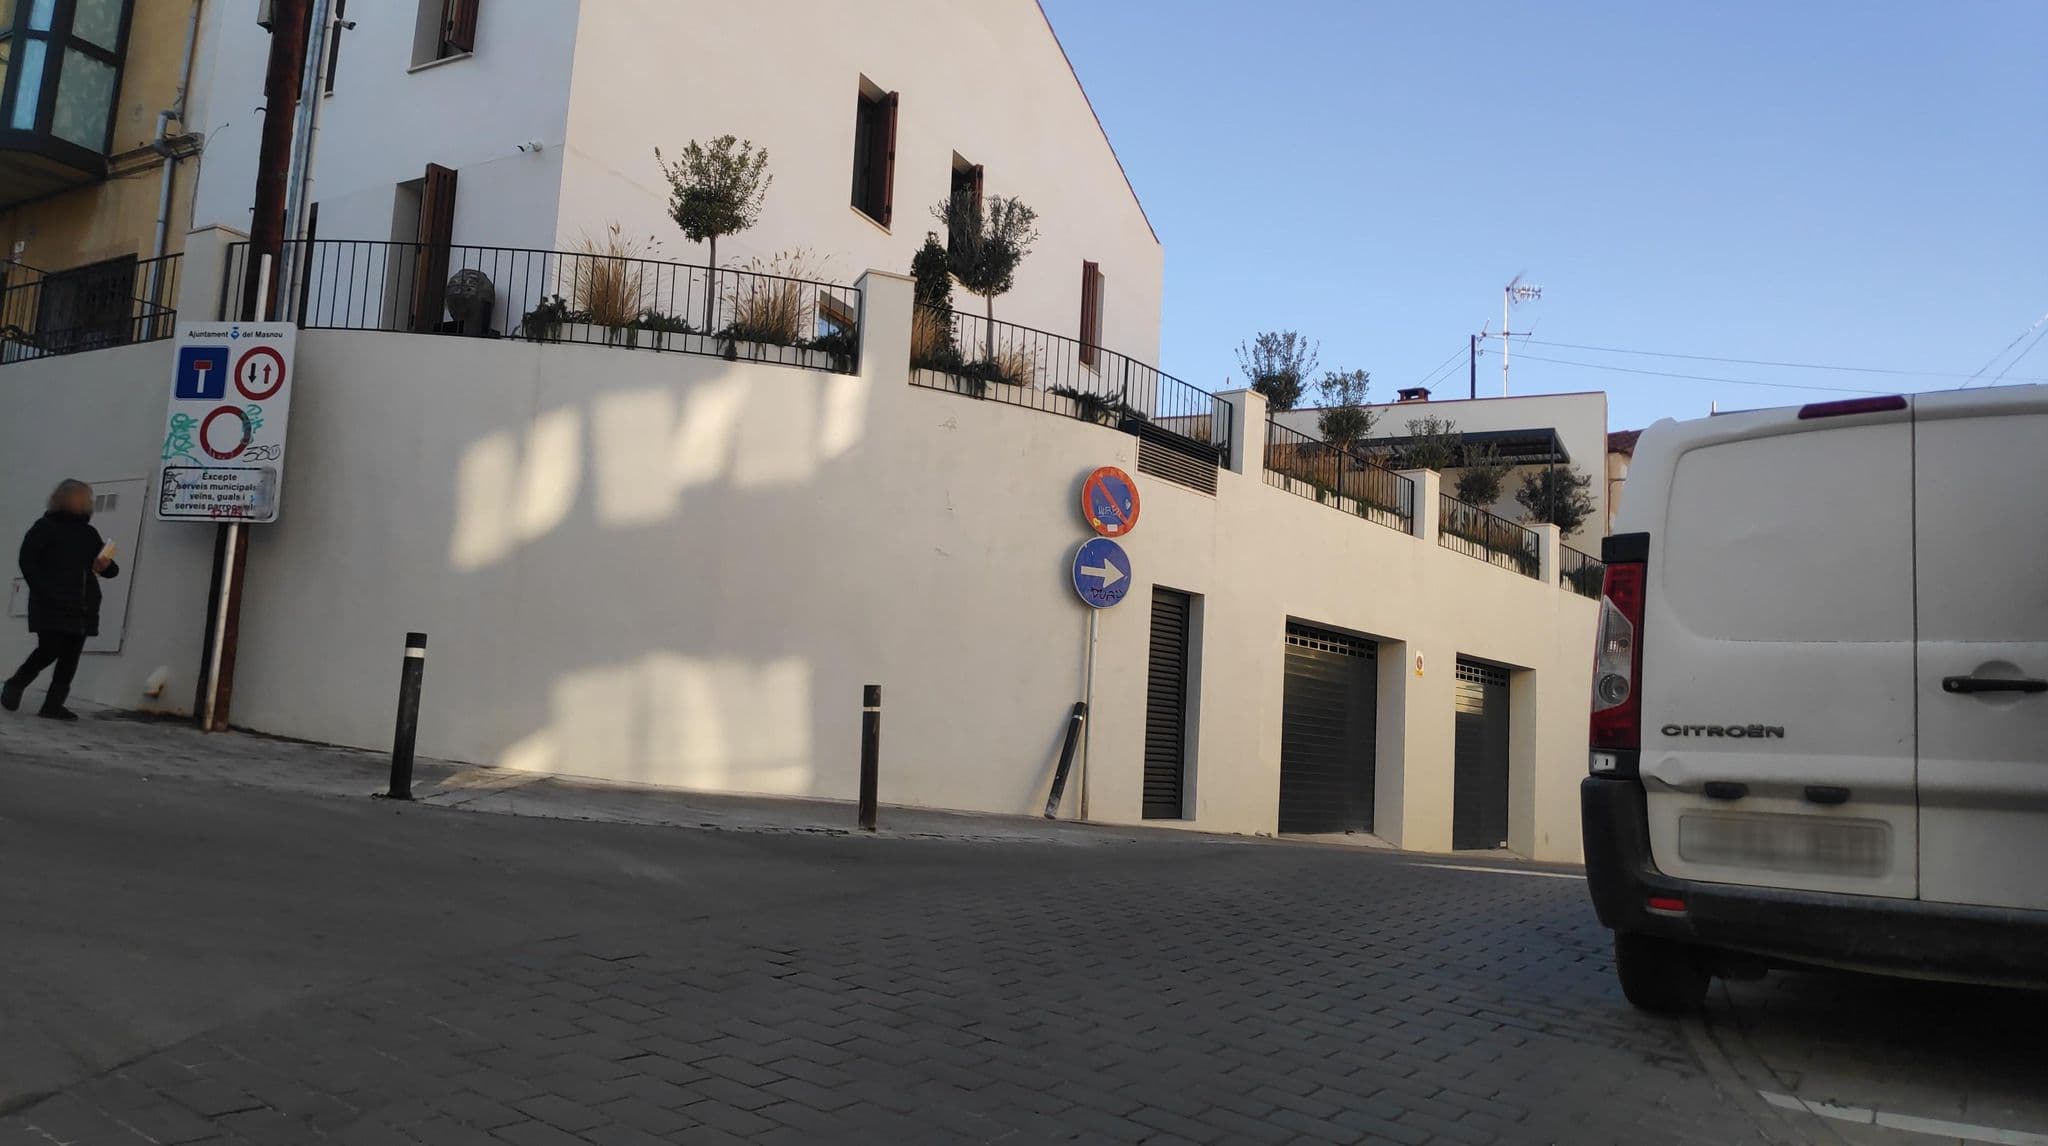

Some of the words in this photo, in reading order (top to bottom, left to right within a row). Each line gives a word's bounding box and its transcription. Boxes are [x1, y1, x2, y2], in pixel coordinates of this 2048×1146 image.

[202, 473, 237, 482] Excepte
[217, 493, 240, 501] guals
[1661, 724, 1784, 738] CITROËN
